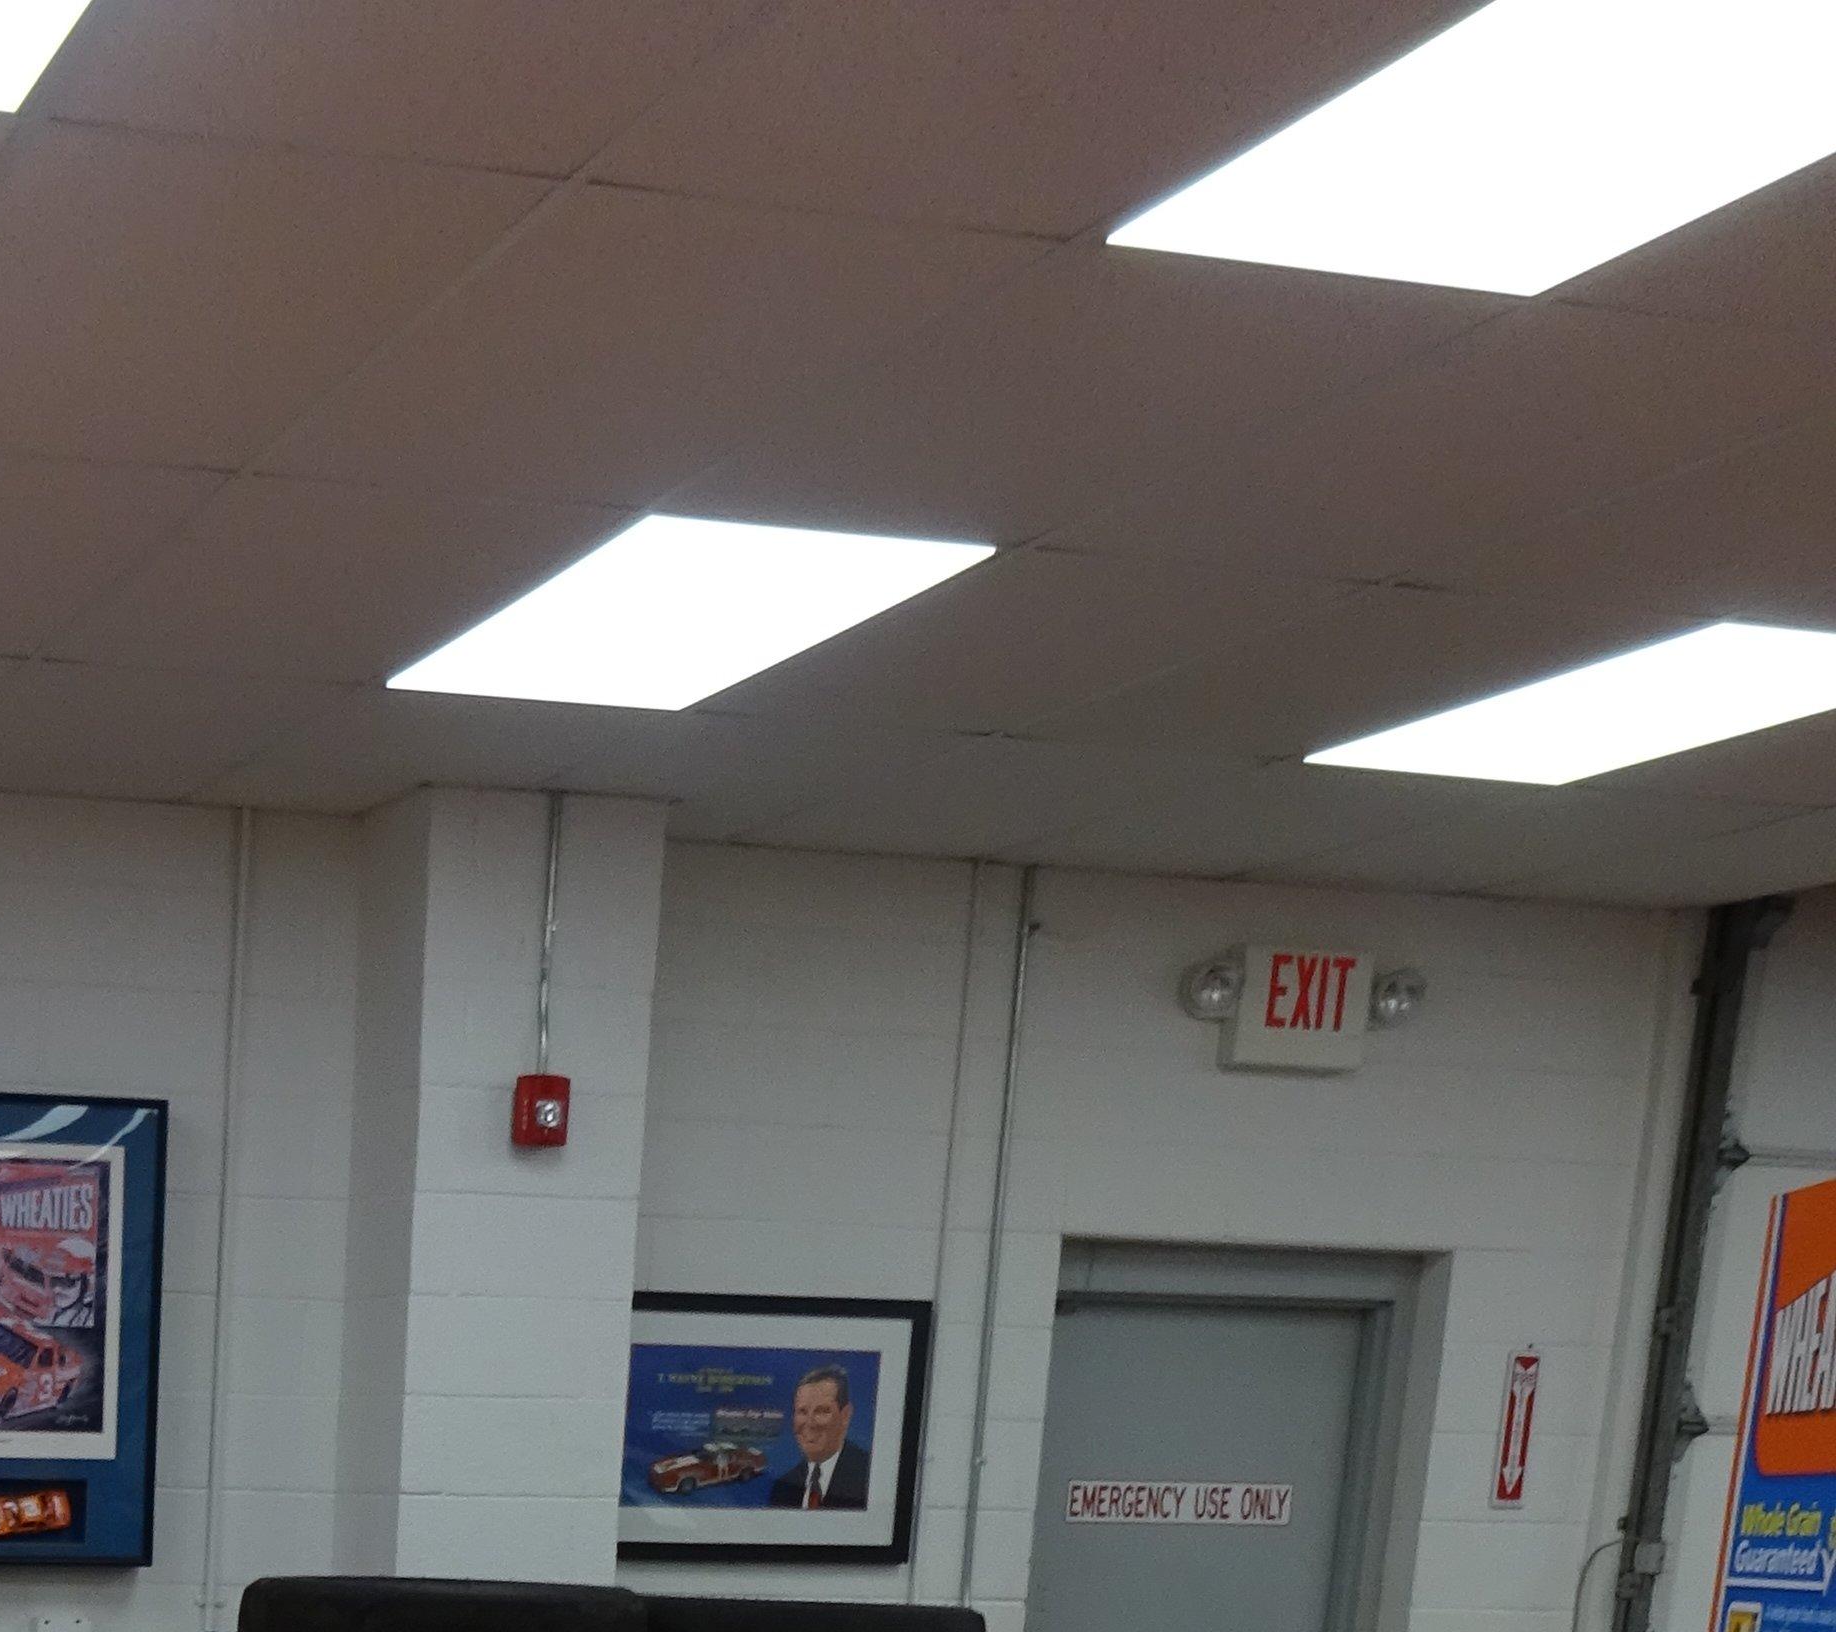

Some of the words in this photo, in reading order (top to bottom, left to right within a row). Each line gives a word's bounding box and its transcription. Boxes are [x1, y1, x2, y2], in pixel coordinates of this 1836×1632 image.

[1264, 952, 1357, 1033] EXIT
[0, 1183, 94, 1234] WHEATIES
[1068, 1484, 1186, 1519] EMERGENCY
[1193, 1486, 1233, 1519] USE
[1239, 1486, 1290, 1520] ONLY
